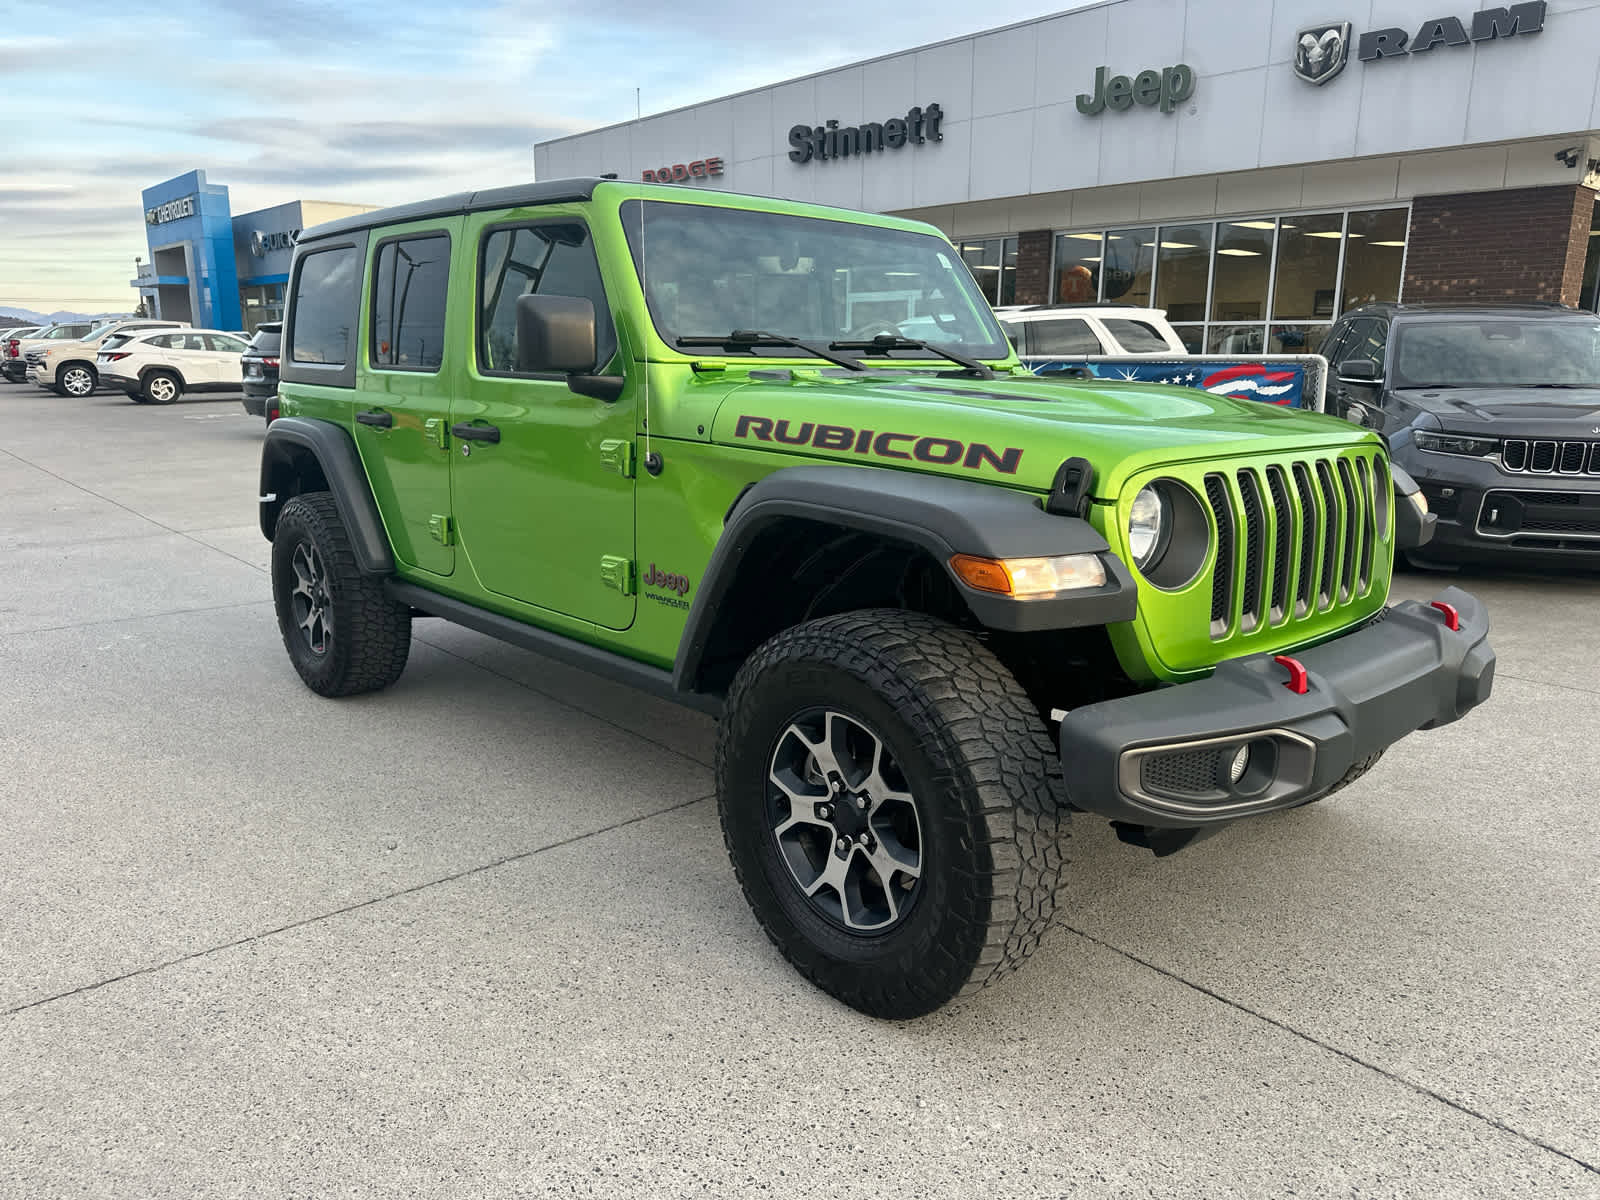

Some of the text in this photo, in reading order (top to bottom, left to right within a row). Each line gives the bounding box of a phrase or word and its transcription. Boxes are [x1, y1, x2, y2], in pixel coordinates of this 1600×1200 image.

[1358, 0, 1547, 61] RAM
[1075, 63, 1197, 115] Jeep
[788, 102, 943, 163] Stinnett
[642, 156, 723, 183] DODGE
[158, 196, 194, 223] CHEVROLET
[262, 229, 299, 250] BUICK
[734, 415, 1024, 475] RUBICON
[642, 562, 689, 597] Jeep
